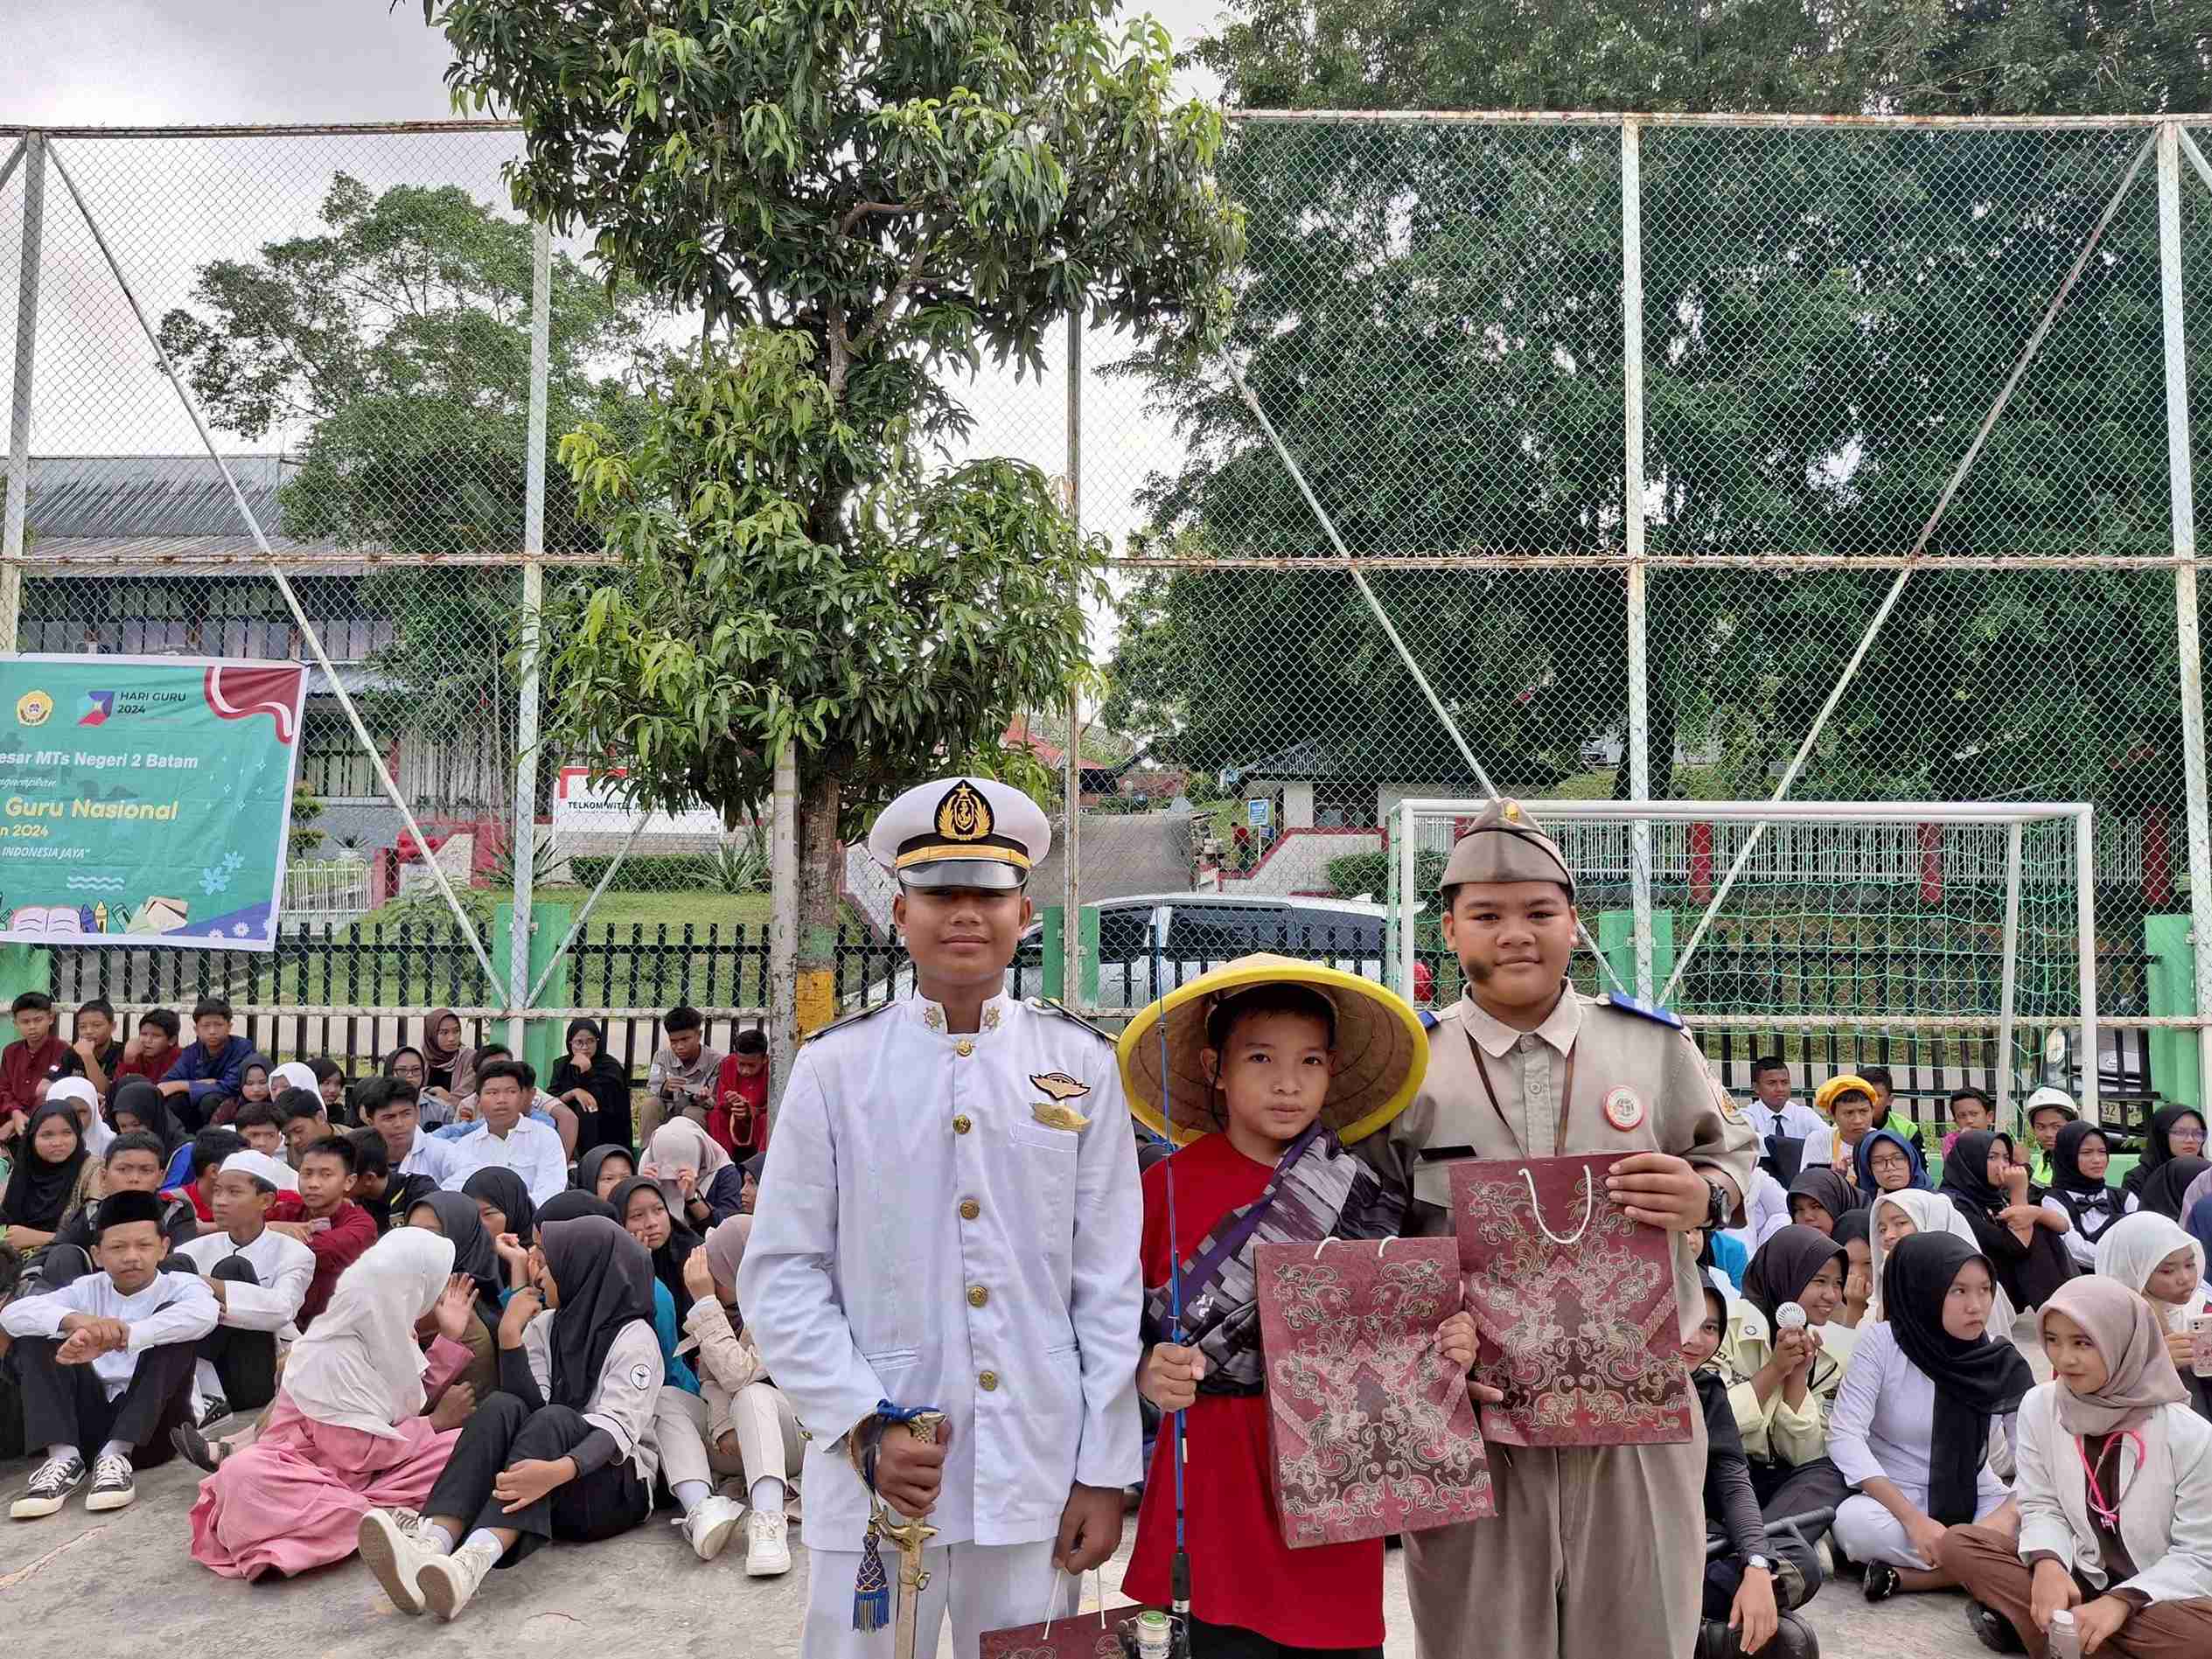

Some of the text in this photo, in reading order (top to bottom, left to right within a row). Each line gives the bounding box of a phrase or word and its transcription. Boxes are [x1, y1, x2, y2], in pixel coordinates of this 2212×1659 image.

[120, 692, 187, 702] HARI GURU
[116, 704, 147, 714] 2024
[35, 751, 70, 765] MTs
[73, 753, 128, 770] Negeri
[132, 755, 143, 768] 2
[145, 755, 199, 769] Batam
[5, 797, 178, 820] Guru Nasional
[568, 801, 604, 810] TELKOM
[12, 823, 50, 838] 2024
[2, 846, 59, 858] INDONESIA
